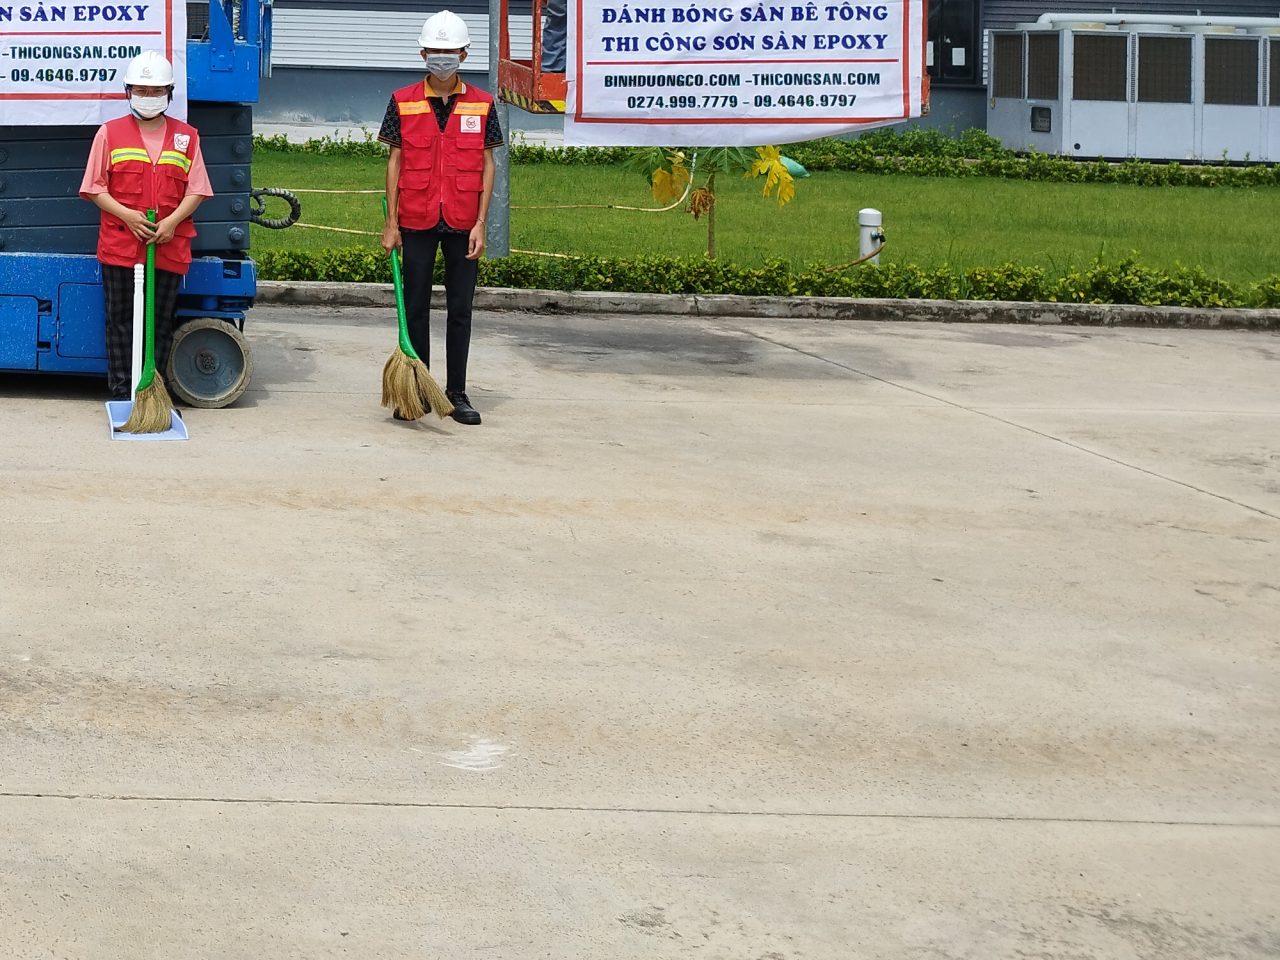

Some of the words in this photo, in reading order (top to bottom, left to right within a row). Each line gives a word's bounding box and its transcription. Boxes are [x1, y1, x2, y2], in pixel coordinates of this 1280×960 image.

[19, 1, 67, 22] SÀN
[73, 5, 150, 22] EPOXY
[601, 3, 666, 23] ĐÁNH
[671, 3, 734, 23] BÓNG
[740, 2, 785, 22] SÀN
[790, 1, 819, 22] BÊ
[825, 1, 889, 21] TÔNG
[601, 36, 640, 52] THI
[645, 31, 707, 52] CÔNG
[712, 32, 756, 51] SƠN
[761, 30, 808, 50] SÀN
[813, 34, 888, 50] EPOXY
[11, 68, 118, 82] 09.4646.9797
[604, 73, 741, 88] BINHDUONGCO.COM
[627, 95, 738, 109] 0274.999.7779
[754, 94, 857, 108] 09.4646.9797
